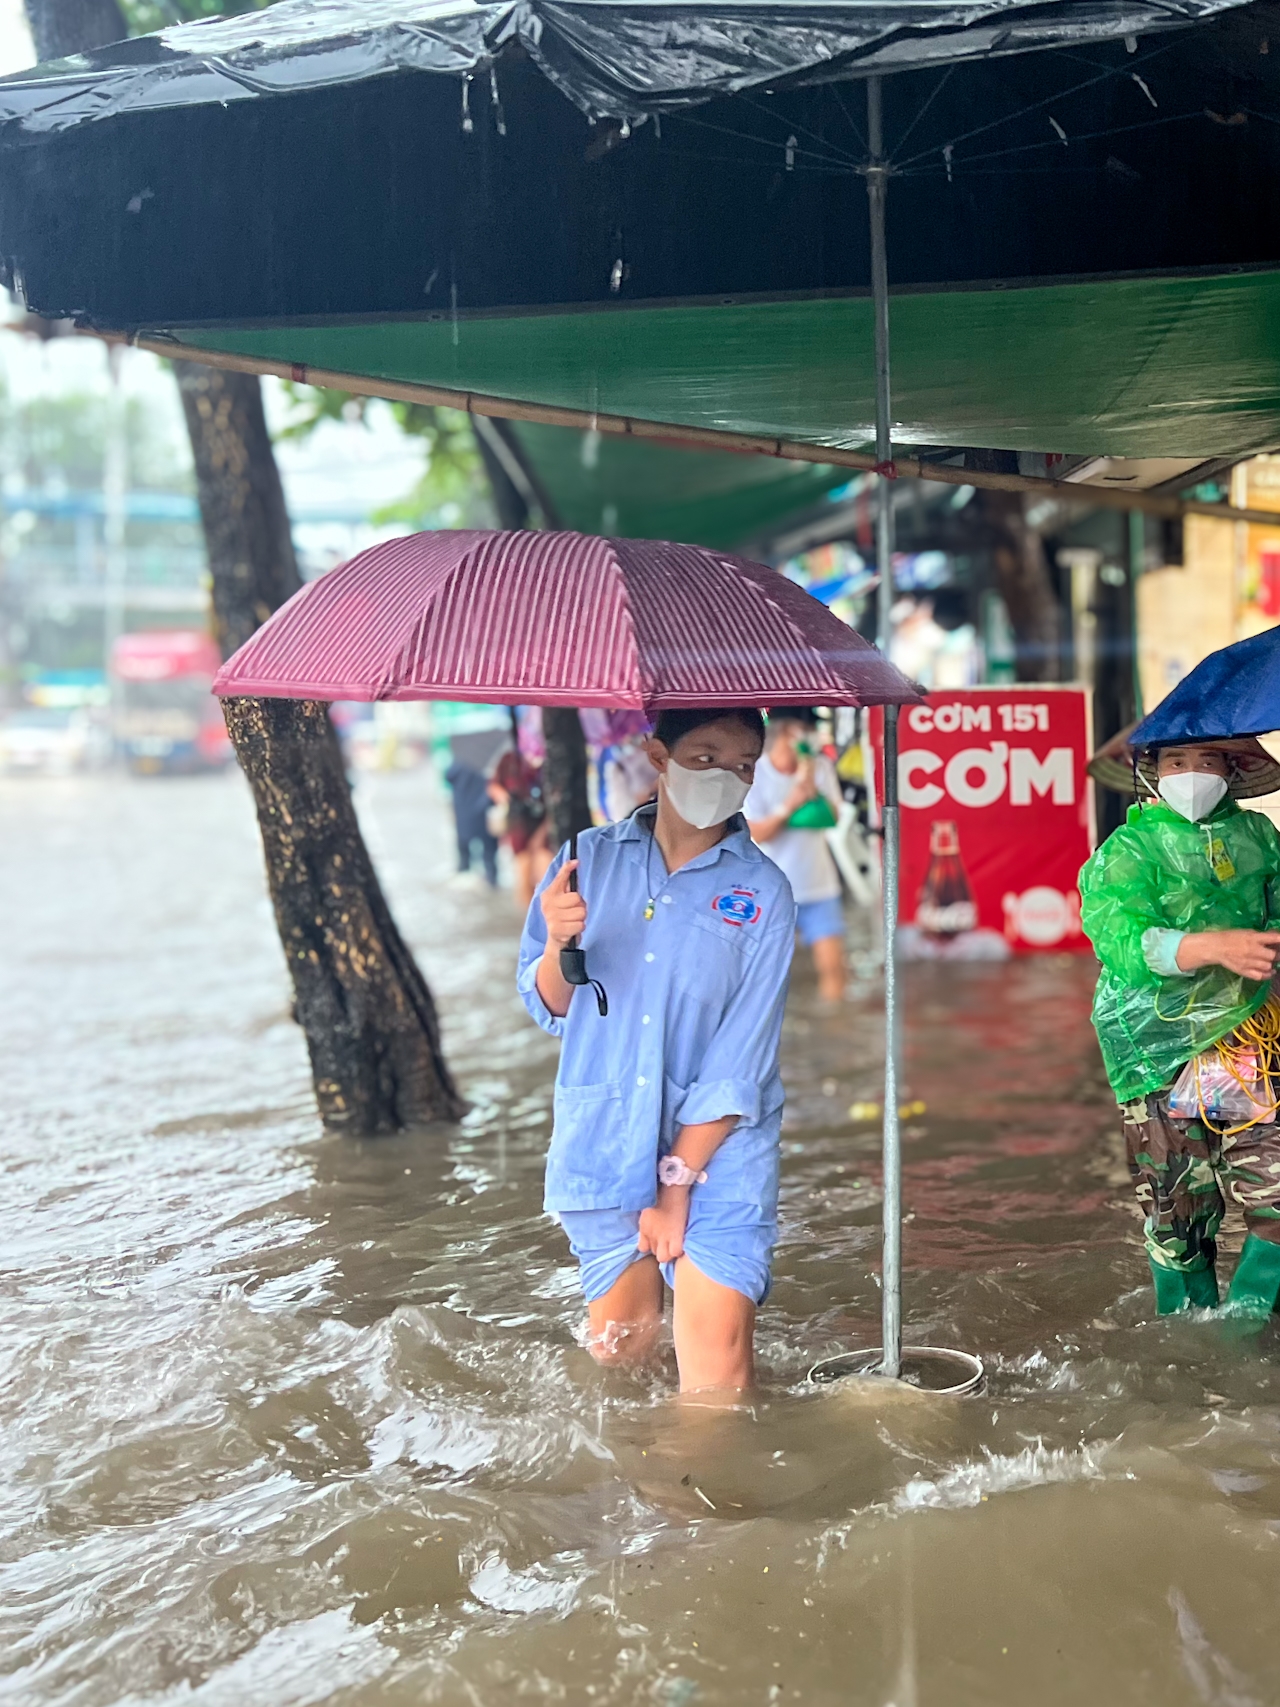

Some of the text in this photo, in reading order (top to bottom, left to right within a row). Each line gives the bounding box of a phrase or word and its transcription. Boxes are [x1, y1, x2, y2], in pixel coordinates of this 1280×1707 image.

[908, 702, 1050, 733] CƠM 151
[897, 741, 1075, 809] CƠM
